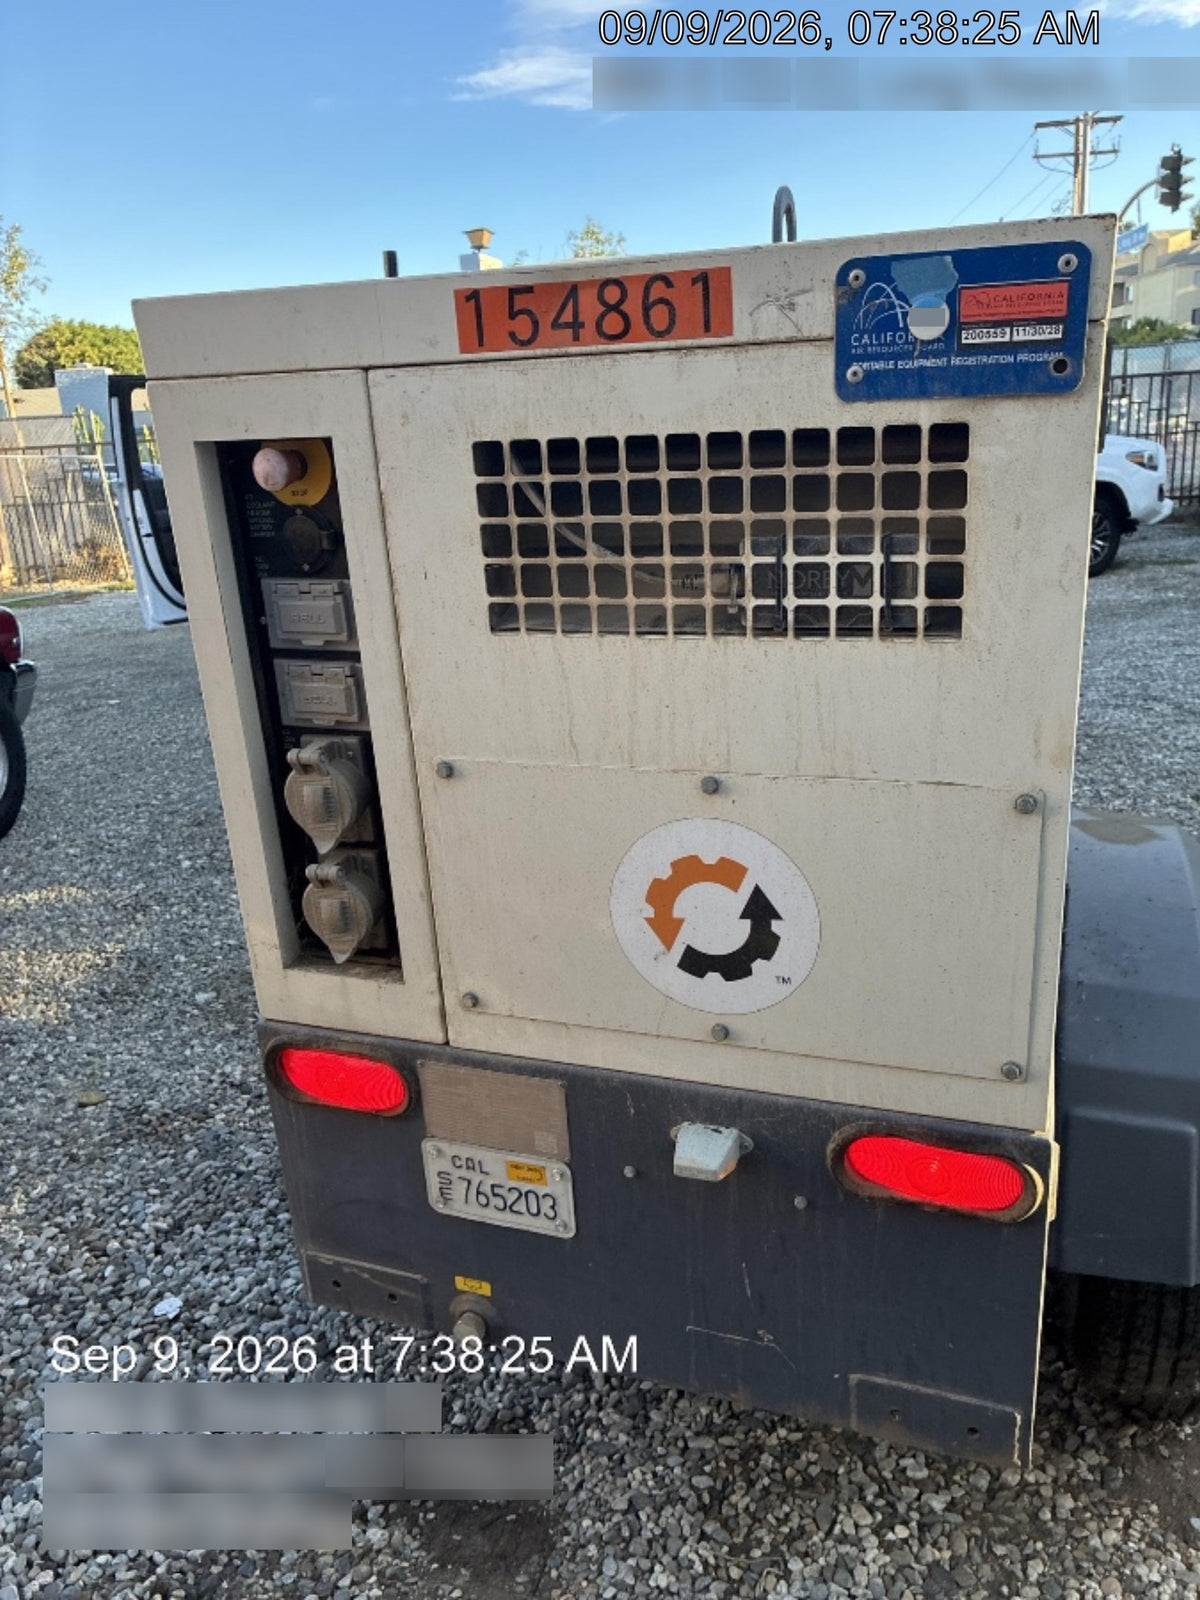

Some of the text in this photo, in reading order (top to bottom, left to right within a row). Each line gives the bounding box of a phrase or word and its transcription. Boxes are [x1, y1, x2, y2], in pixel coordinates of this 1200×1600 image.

[464, 272, 710, 347] 154861
[951, 354, 1014, 367] REGISTRATION
[774, 975, 792, 985] TM
[451, 1155, 490, 1175] CAL
[457, 1176, 558, 1220] 765203
